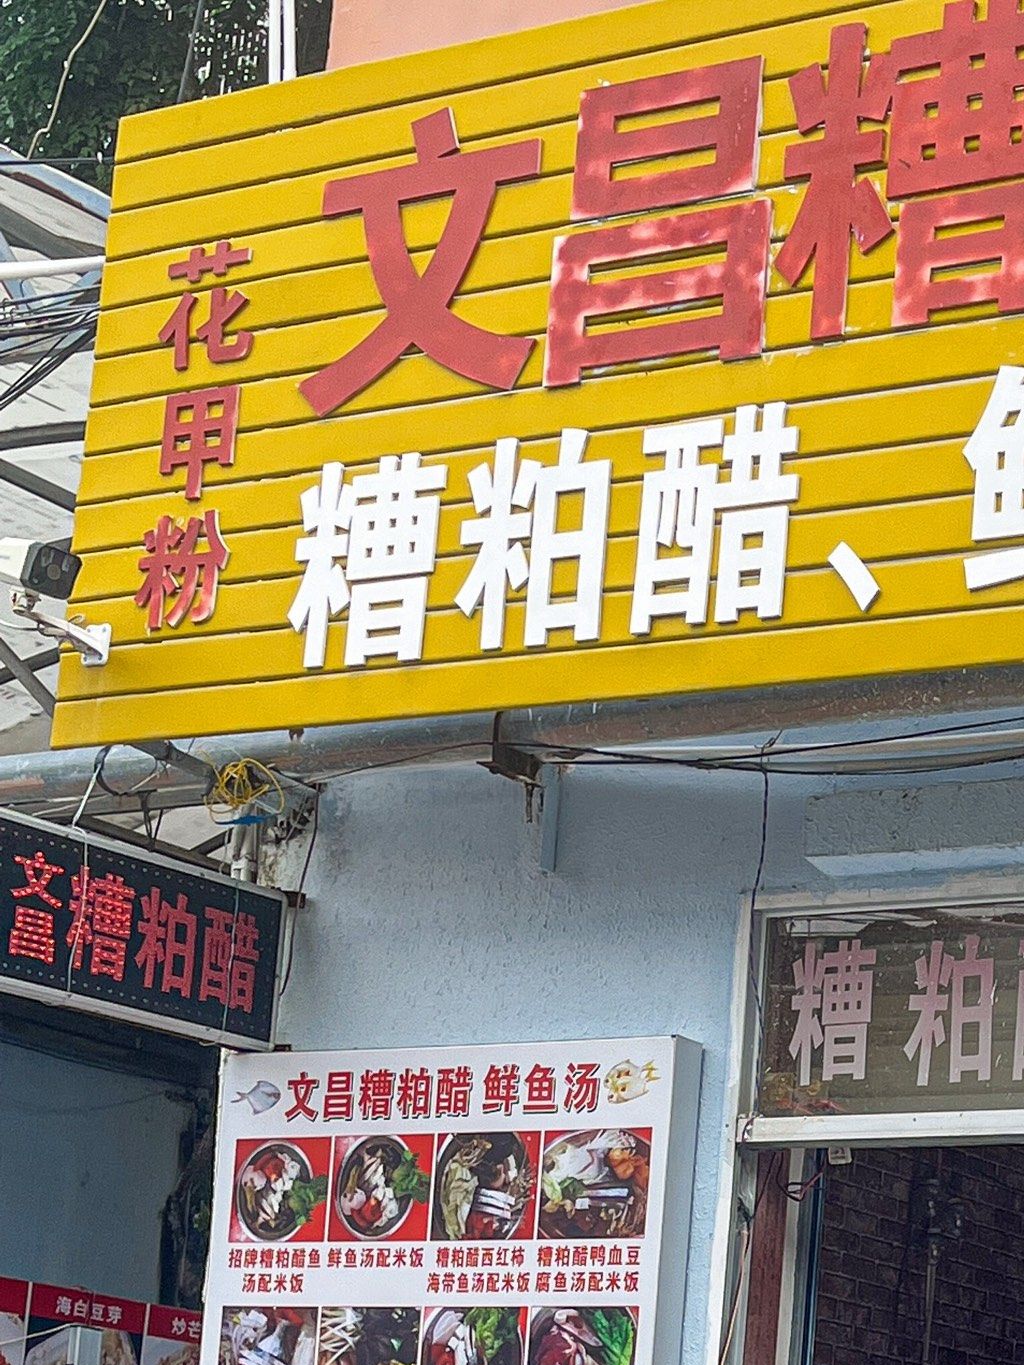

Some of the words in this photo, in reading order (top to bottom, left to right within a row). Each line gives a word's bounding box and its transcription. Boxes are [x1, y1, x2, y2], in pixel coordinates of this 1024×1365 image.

[133, 240, 255, 634] 花甲粉
[9, 850, 65, 966] 文昌
[66, 864, 261, 1014] 糟粕醋
[285, 1066, 471, 1123] 文昌糟粕醋
[483, 1062, 602, 1116] 鲜鱼汤
[228, 1248, 320, 1268] 招牌糟粕醋鱼
[327, 1247, 424, 1268] 鲜鱼汤配米饭
[436, 1246, 525, 1267] 糟粕醋西红柿
[537, 1244, 641, 1267] 糟粕醋鸭血豆
[242, 1273, 304, 1293] 汤配米饭
[427, 1272, 530, 1293] 海带鱼汤配米饭
[535, 1270, 640, 1293] 腐鱼汤配米饭
[55, 1296, 123, 1325] 海白豆芽
